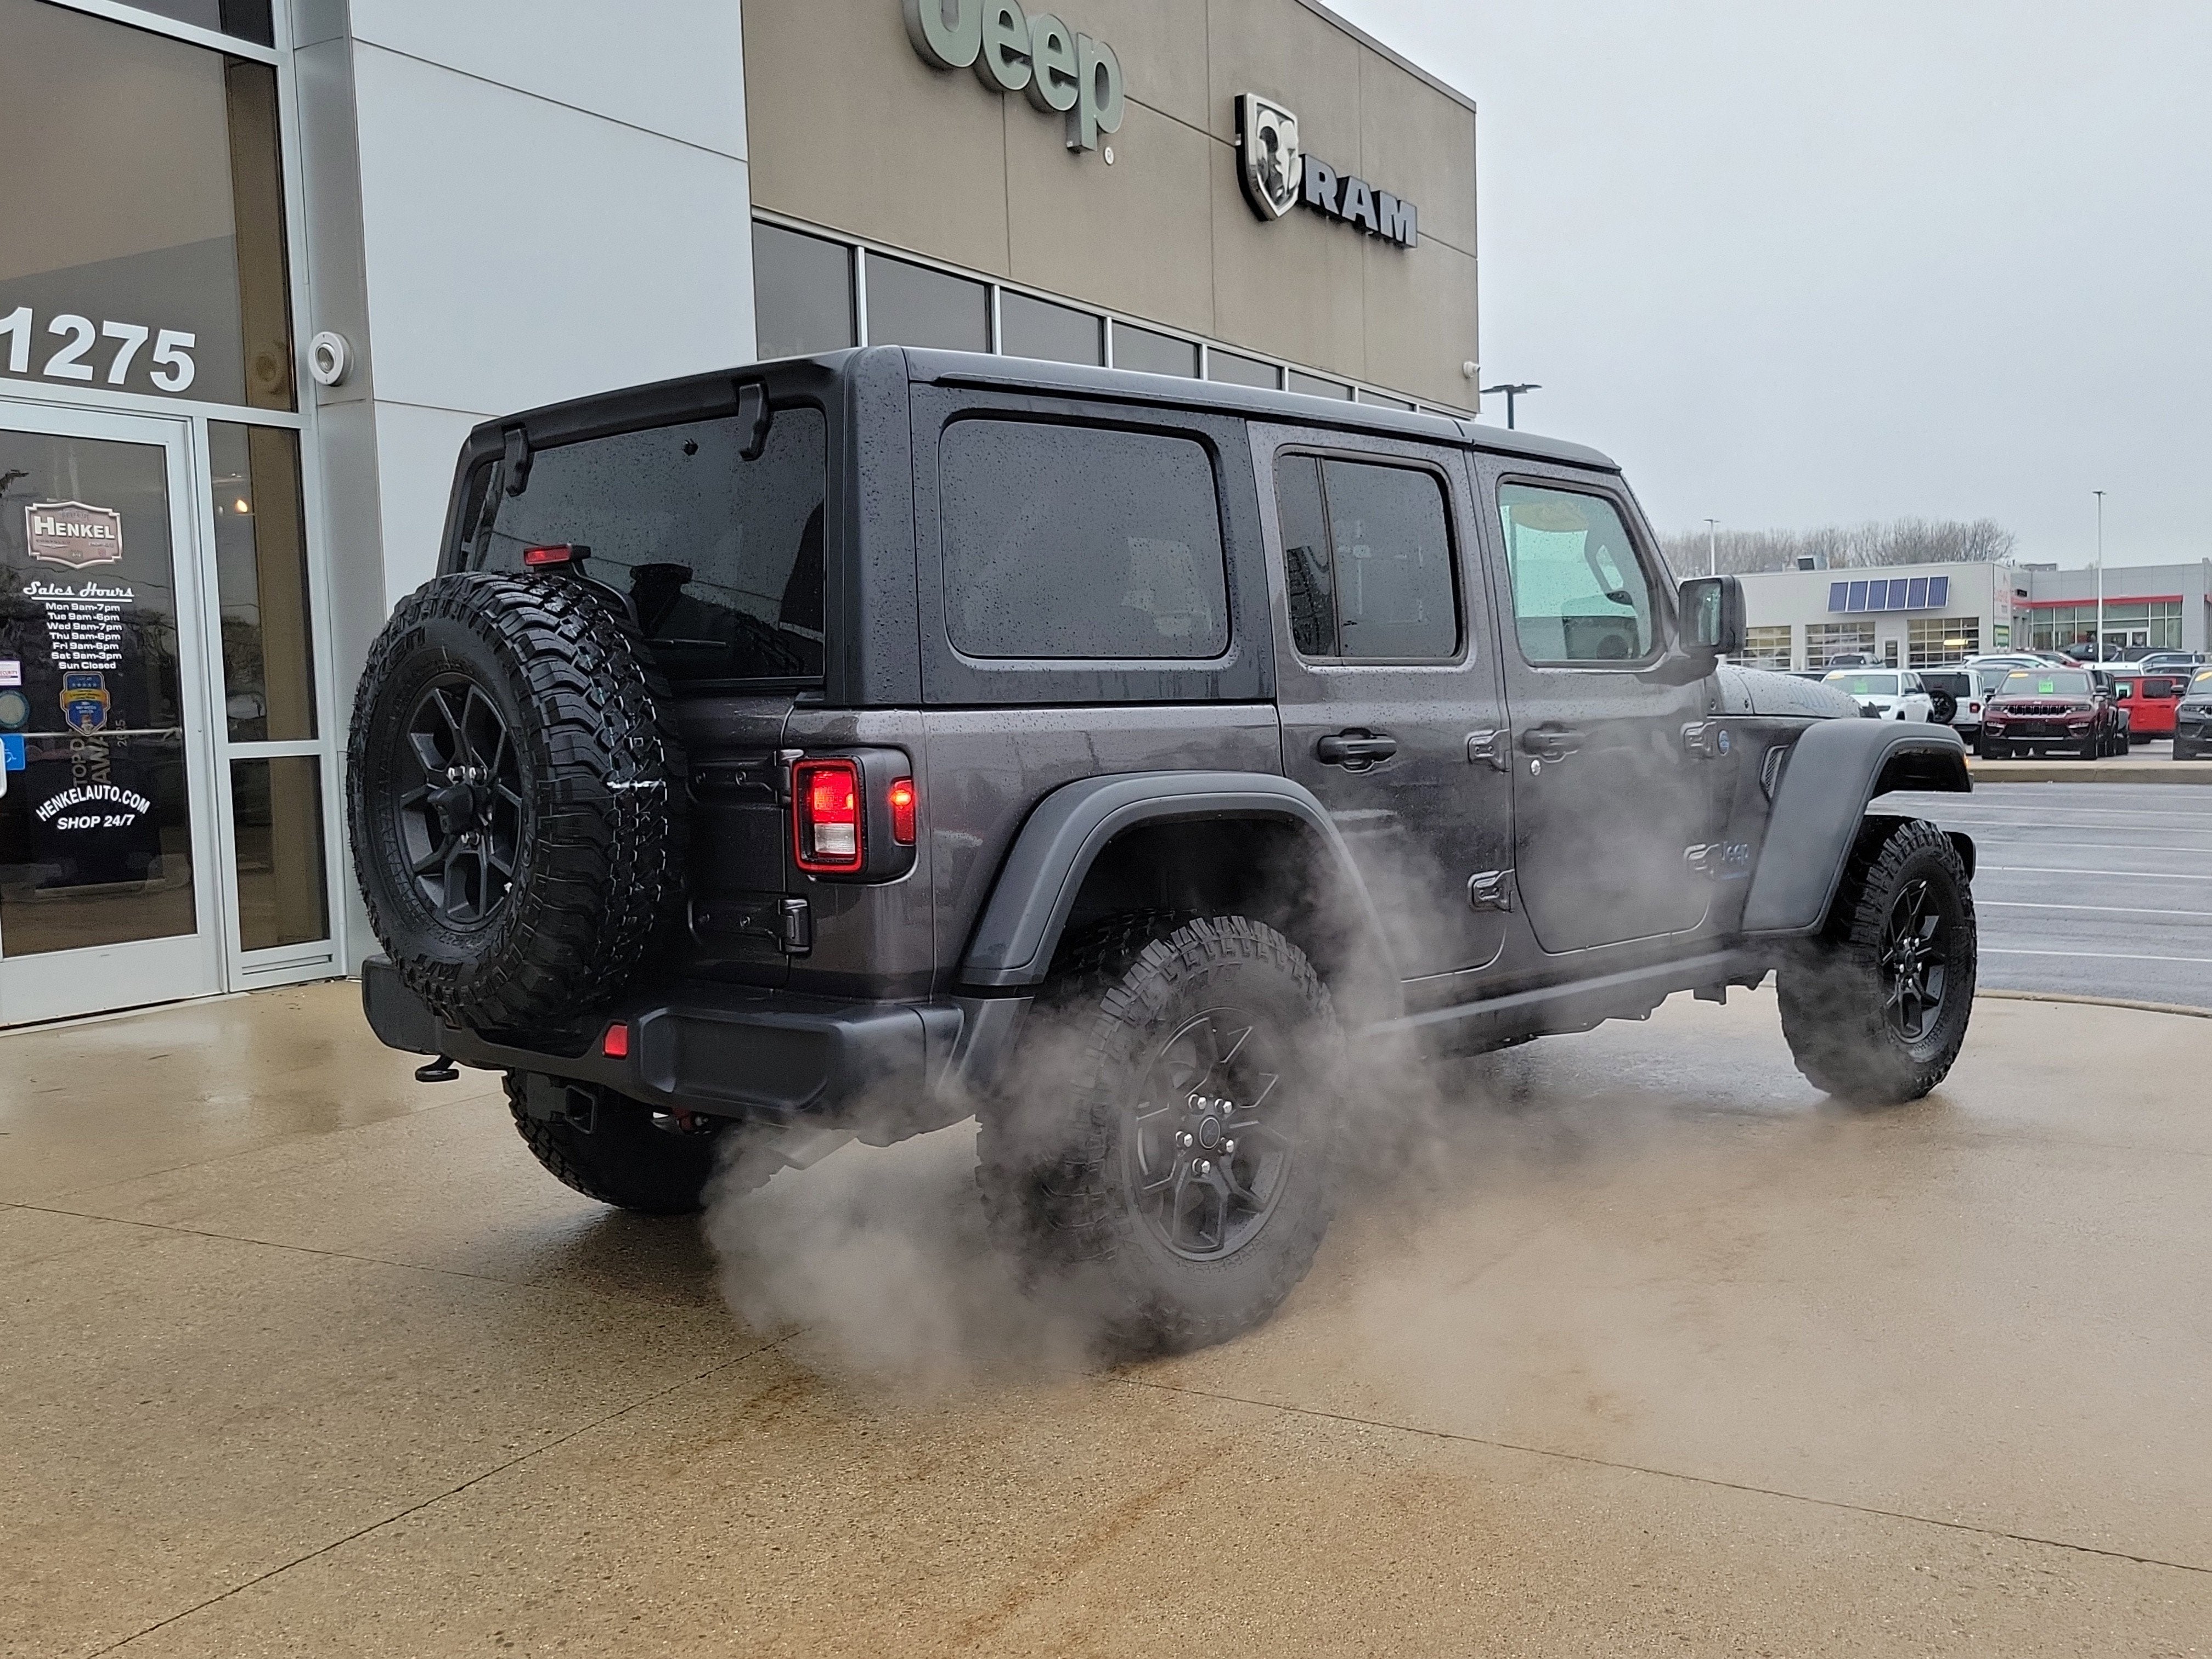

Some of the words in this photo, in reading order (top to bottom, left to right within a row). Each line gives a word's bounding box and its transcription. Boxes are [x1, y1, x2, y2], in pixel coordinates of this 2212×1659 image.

[1304, 153, 1417, 247] RAM
[0, 307, 195, 392] 1275
[33, 516, 115, 539] HENKEL
[23, 581, 75, 595] Sales
[80, 582, 134, 597] Hours
[46, 602, 69, 611] Mon
[71, 603, 120, 612] 9am-7pm
[72, 623, 122, 631] 9am-7pm
[71, 633, 121, 641] 9am-6pm
[70, 642, 119, 651] 9am-6pm
[73, 652, 122, 661] 9am-3pm
[71, 754, 88, 787] TOP
[36, 785, 151, 822] HENKELAUTO.COM
[57, 816, 101, 830] SHOP
[103, 814, 135, 828] 24/7
